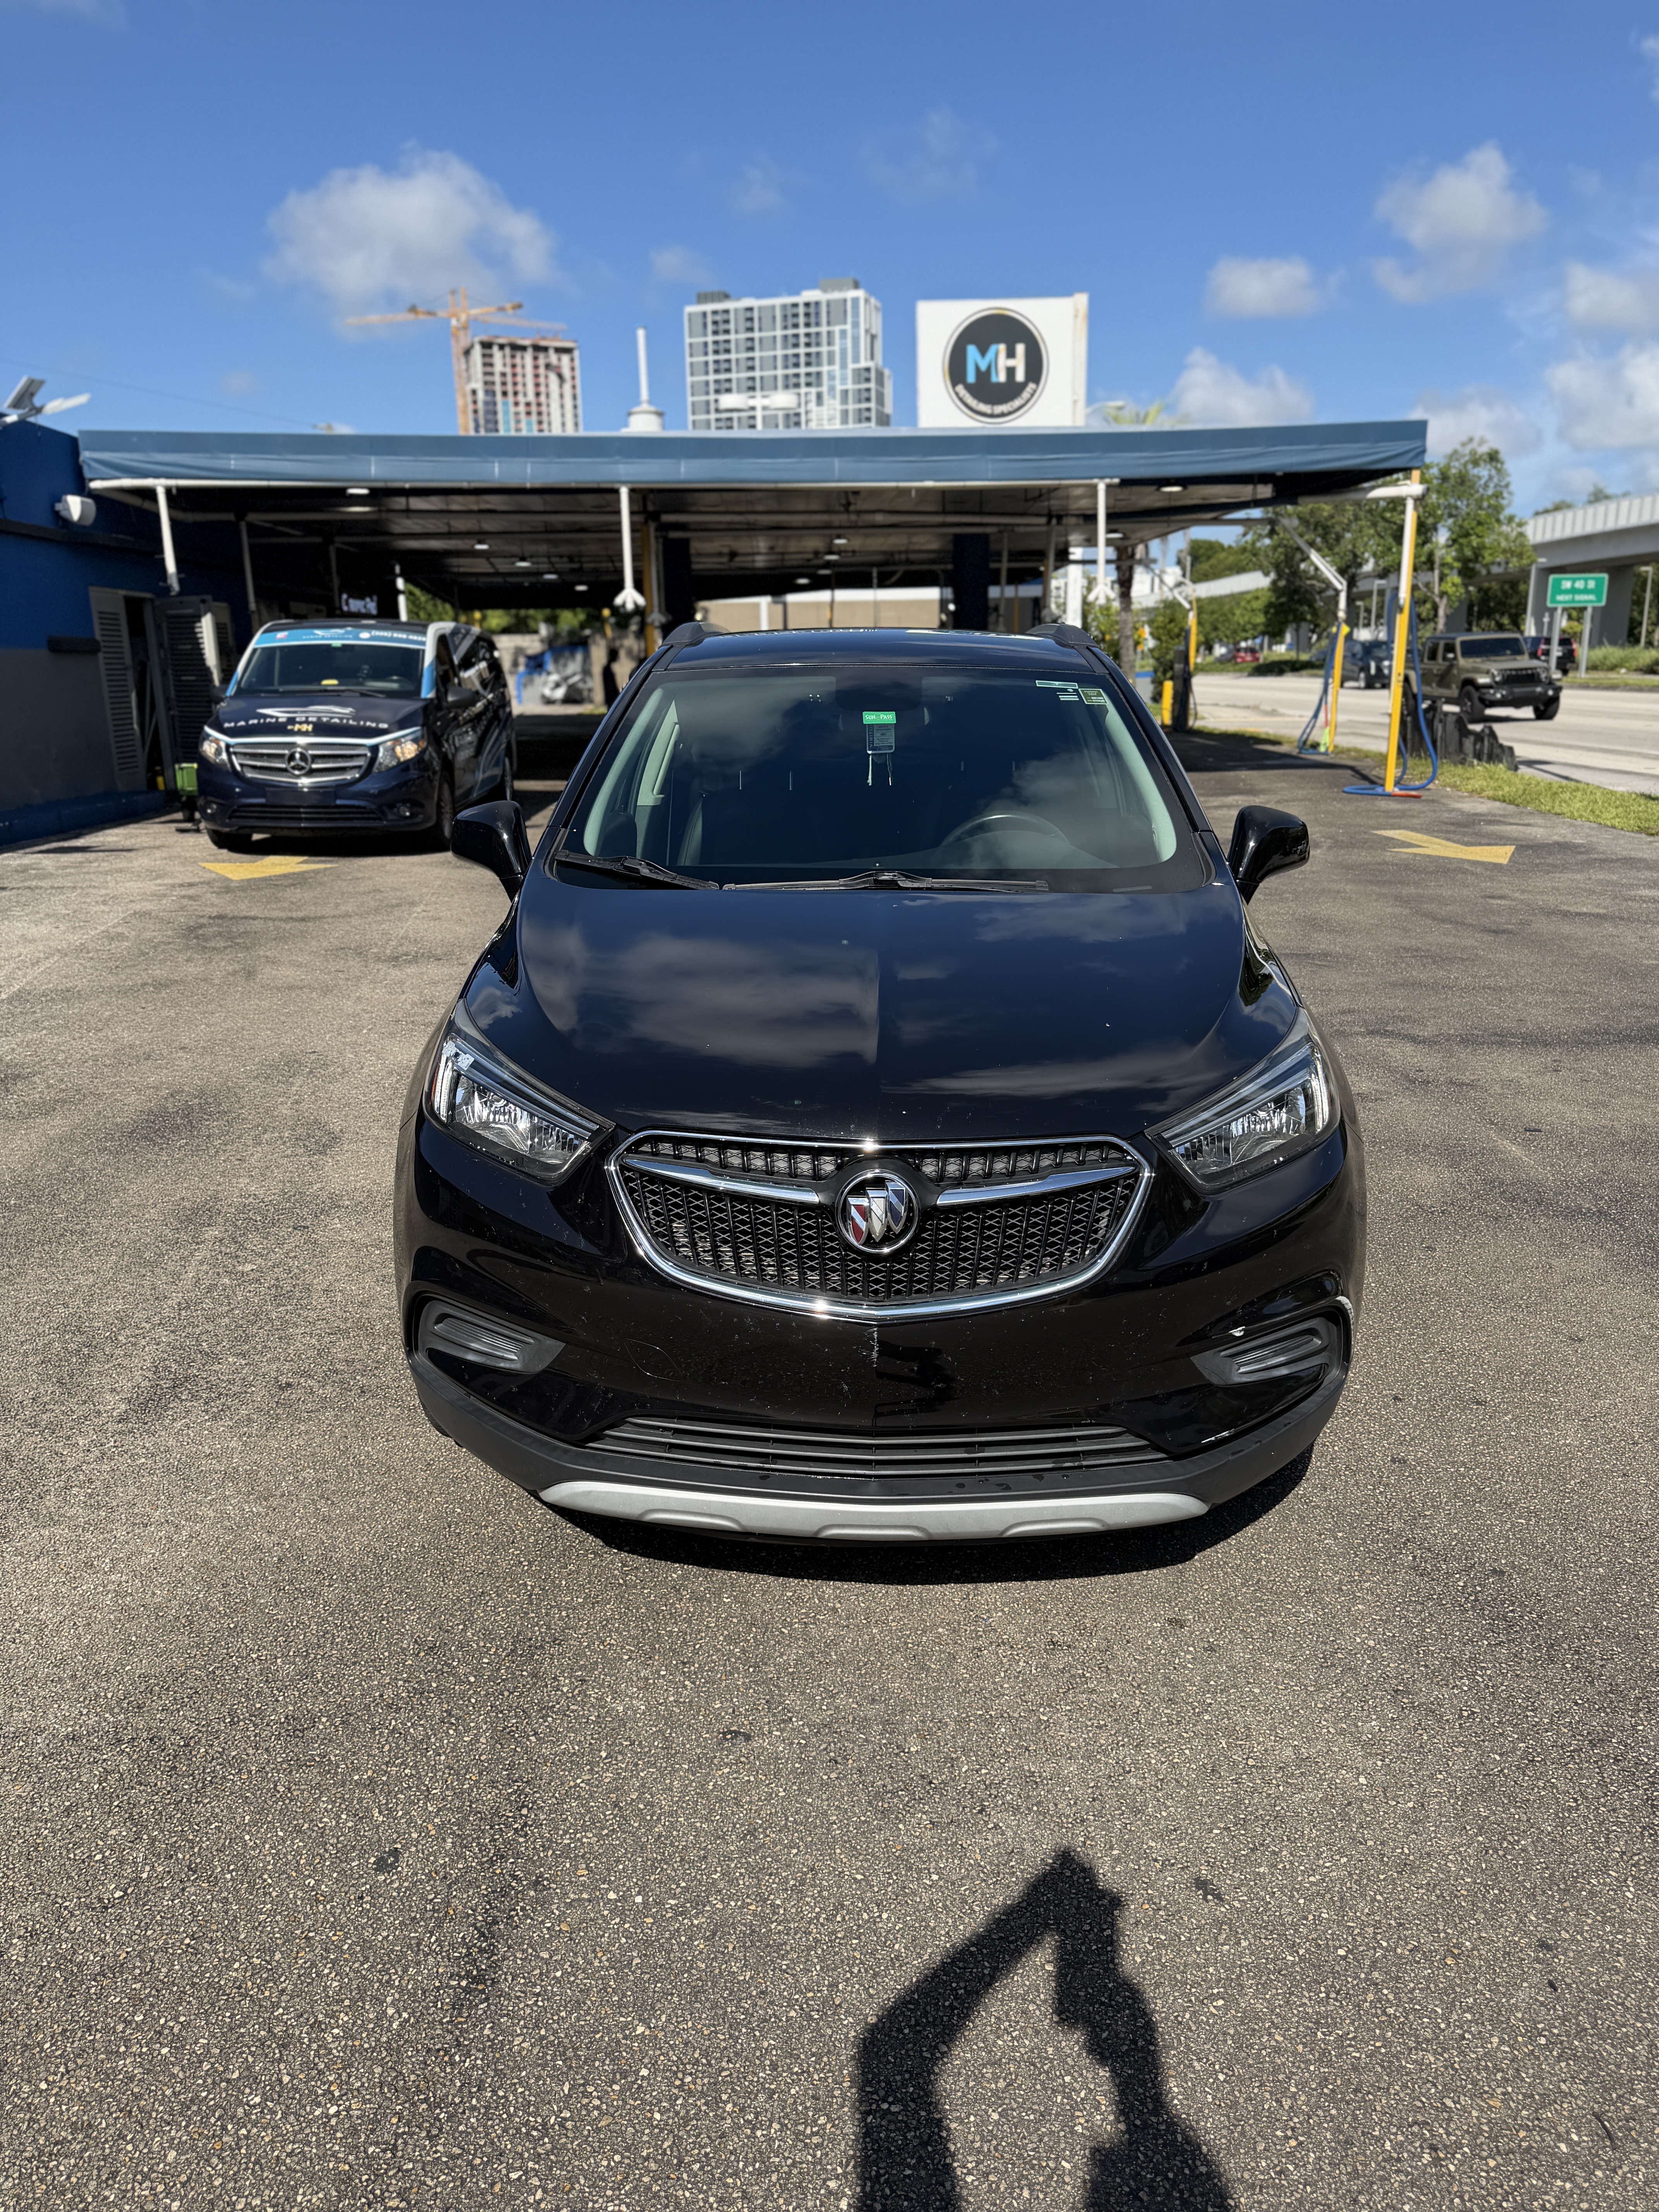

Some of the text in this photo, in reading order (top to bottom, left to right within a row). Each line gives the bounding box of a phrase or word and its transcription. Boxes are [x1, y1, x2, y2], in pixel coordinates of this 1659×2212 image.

[966, 343, 1025, 383] MH
[955, 381, 1037, 415] DETAILING SPECIALISTS
[1561, 580, 1572, 589] SW
[1573, 579, 1585, 589] 40
[223, 717, 388, 728] MARINE DETAILING
[294, 723, 313, 732] MH
